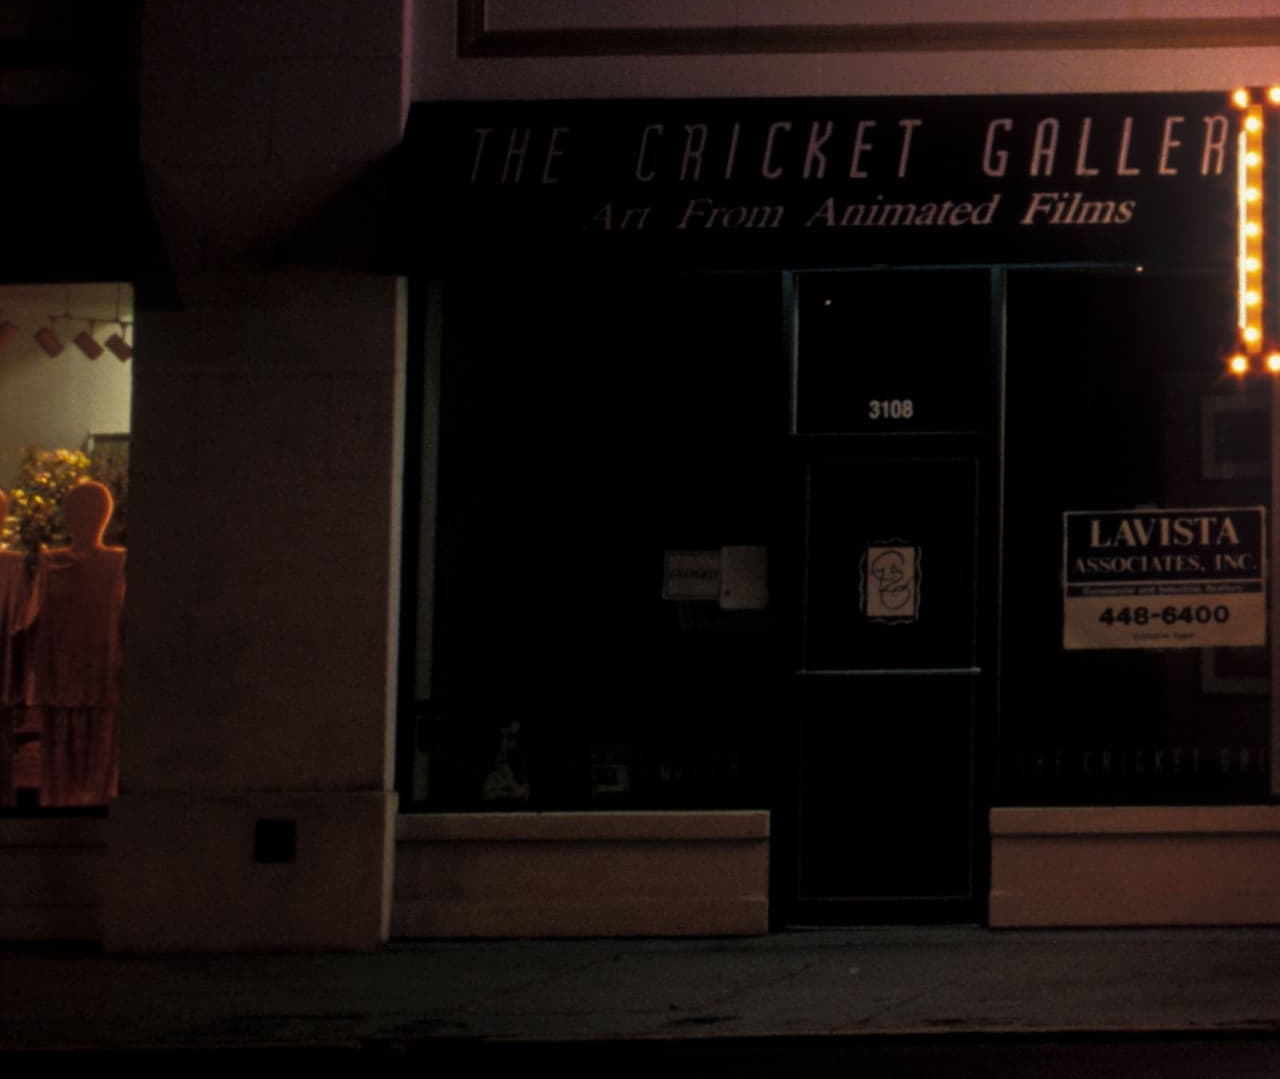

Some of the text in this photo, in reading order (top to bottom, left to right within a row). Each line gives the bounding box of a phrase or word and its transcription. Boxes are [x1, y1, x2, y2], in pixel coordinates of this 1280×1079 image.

[469, 126, 570, 184] THE
[634, 118, 926, 183] CRICKET
[581, 192, 1136, 231] Art From Animated Films
[867, 399, 915, 421] 3108
[1088, 515, 1241, 550] LAVISTA
[1099, 605, 1231, 626] 448-6400
